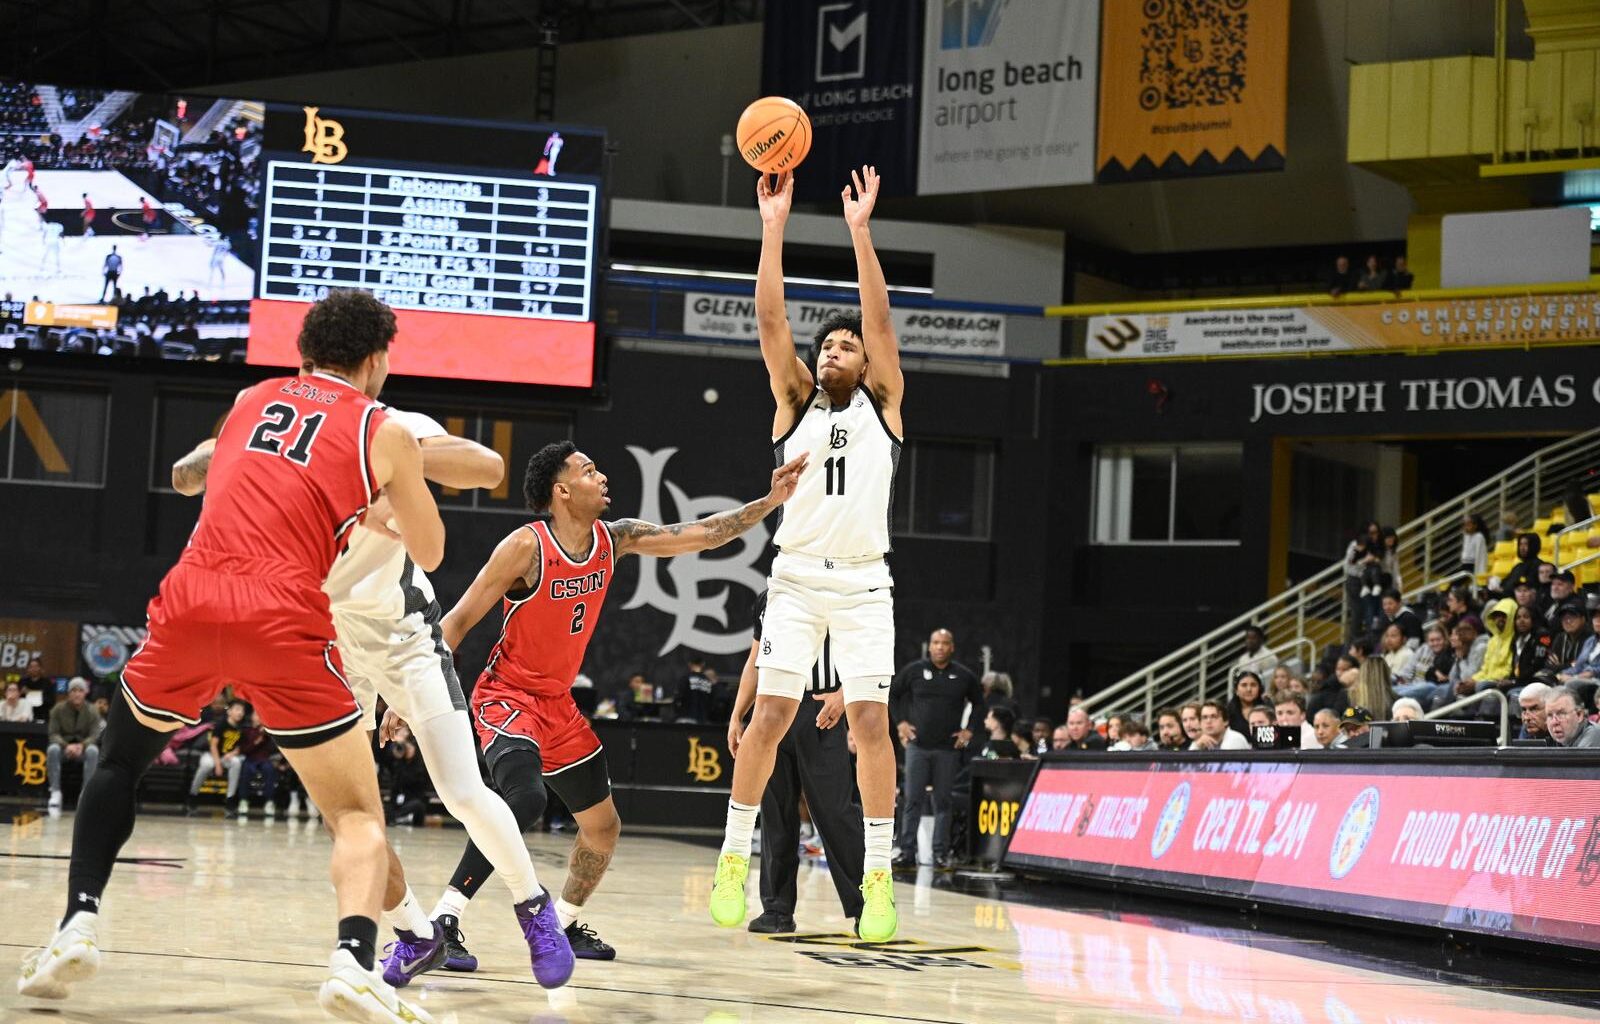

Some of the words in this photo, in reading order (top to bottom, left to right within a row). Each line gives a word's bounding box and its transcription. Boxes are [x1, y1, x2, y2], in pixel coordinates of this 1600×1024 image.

[938, 67, 995, 95] long
[1004, 55, 1083, 87] beach
[814, 88, 856, 107] LONG
[860, 83, 914, 104] BEACH
[935, 98, 1018, 130] airport
[302, 105, 349, 165] LB
[745, 128, 787, 162] Wilson
[315, 170, 325, 185] 1
[388, 175, 482, 197] Rebounds
[537, 187, 549, 202] 3
[401, 195, 467, 214] Assists
[536, 205, 549, 219] 2
[313, 207, 323, 221] 1
[402, 214, 459, 232] Steals
[537, 223, 547, 238] 1
[380, 231, 449, 250] 3-Point
[451, 236, 480, 253] FG
[368, 250, 438, 270] 3-Point
[441, 255, 469, 272] FG
[380, 270, 427, 288] Field
[430, 274, 475, 291] Goal
[423, 292, 468, 308] Goal
[693, 297, 756, 318] GLEN
[905, 315, 1001, 332] #GOBEACH
[1184, 315, 1231, 325] Awarded
[1233, 315, 1245, 324] to
[1247, 313, 1265, 322] the
[1267, 312, 1294, 321] most
[1203, 327, 1260, 337] successful
[1261, 326, 1279, 336] Big
[1282, 324, 1307, 334] West
[901, 334, 1000, 349] getdodge.com
[1142, 341, 1178, 353] WEST
[1145, 329, 1168, 341] BIG
[1280, 338, 1303, 348] each
[1305, 338, 1331, 348] year
[280, 379, 341, 405] LEWIS
[1250, 381, 1386, 423] JOSEPH
[1401, 375, 1576, 411] THOMAS
[245, 400, 328, 468] 21
[824, 456, 846, 496] 11
[550, 569, 606, 600] CSUN
[570, 601, 586, 635] 2
[1257, 726, 1275, 743] POSS
[978, 799, 999, 836] GO
[1193, 796, 1246, 852] OPEN
[1262, 801, 1318, 860] 2AM
[1390, 810, 1462, 868] PROUD
[1450, 812, 1552, 877] SPONSOR
[1541, 817, 1586, 879] OF
